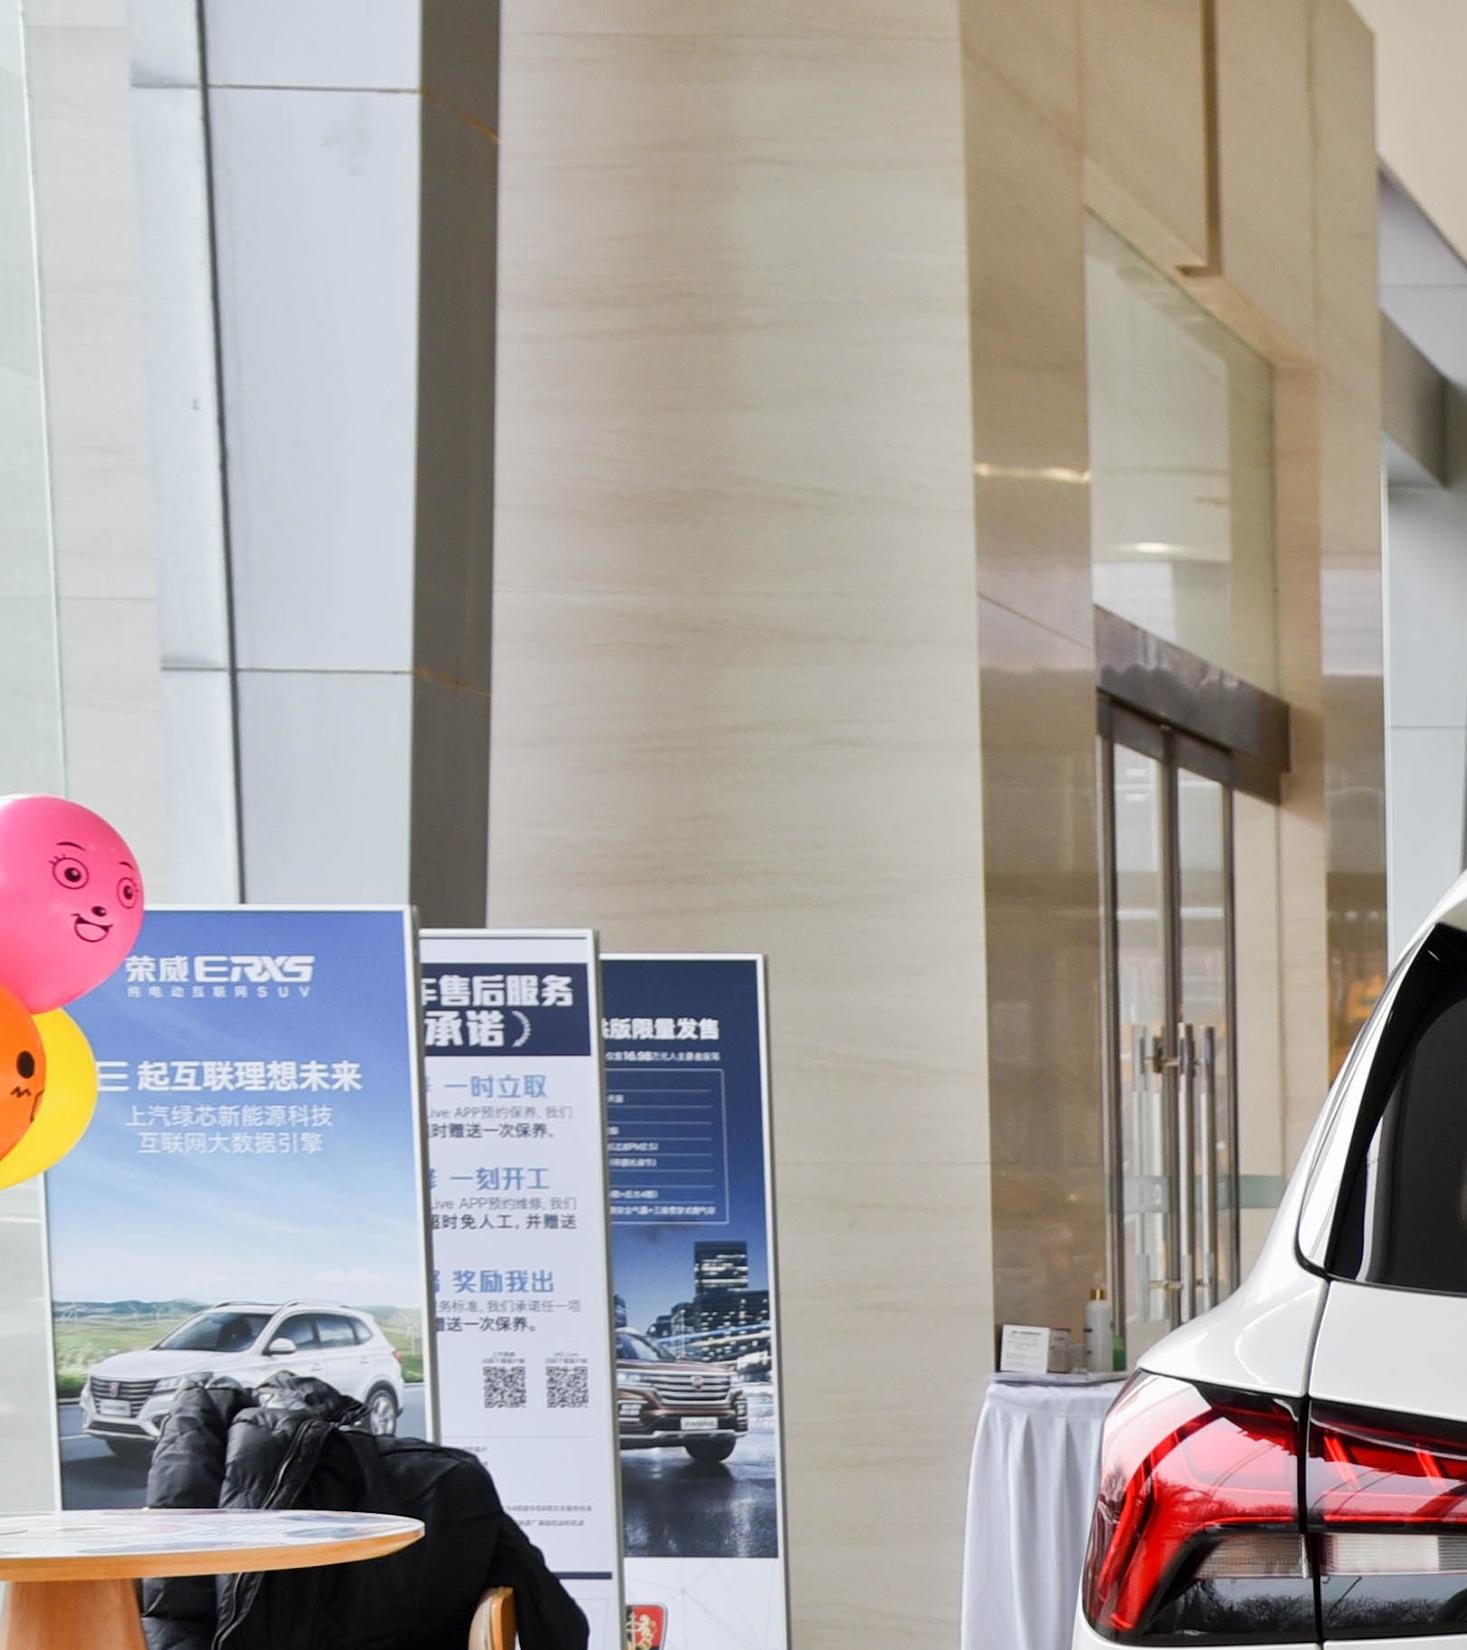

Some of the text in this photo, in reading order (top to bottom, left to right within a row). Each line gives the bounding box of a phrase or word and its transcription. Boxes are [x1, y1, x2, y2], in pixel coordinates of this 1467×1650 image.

[444, 1075, 547, 1098] 一时立取
[125, 1104, 334, 1127] 上汽绿芯新能源科技
[137, 1132, 324, 1154] 互联网大数据引擎
[450, 1167, 550, 1190] 一刻开工
[453, 1270, 554, 1293] 奖励我出
